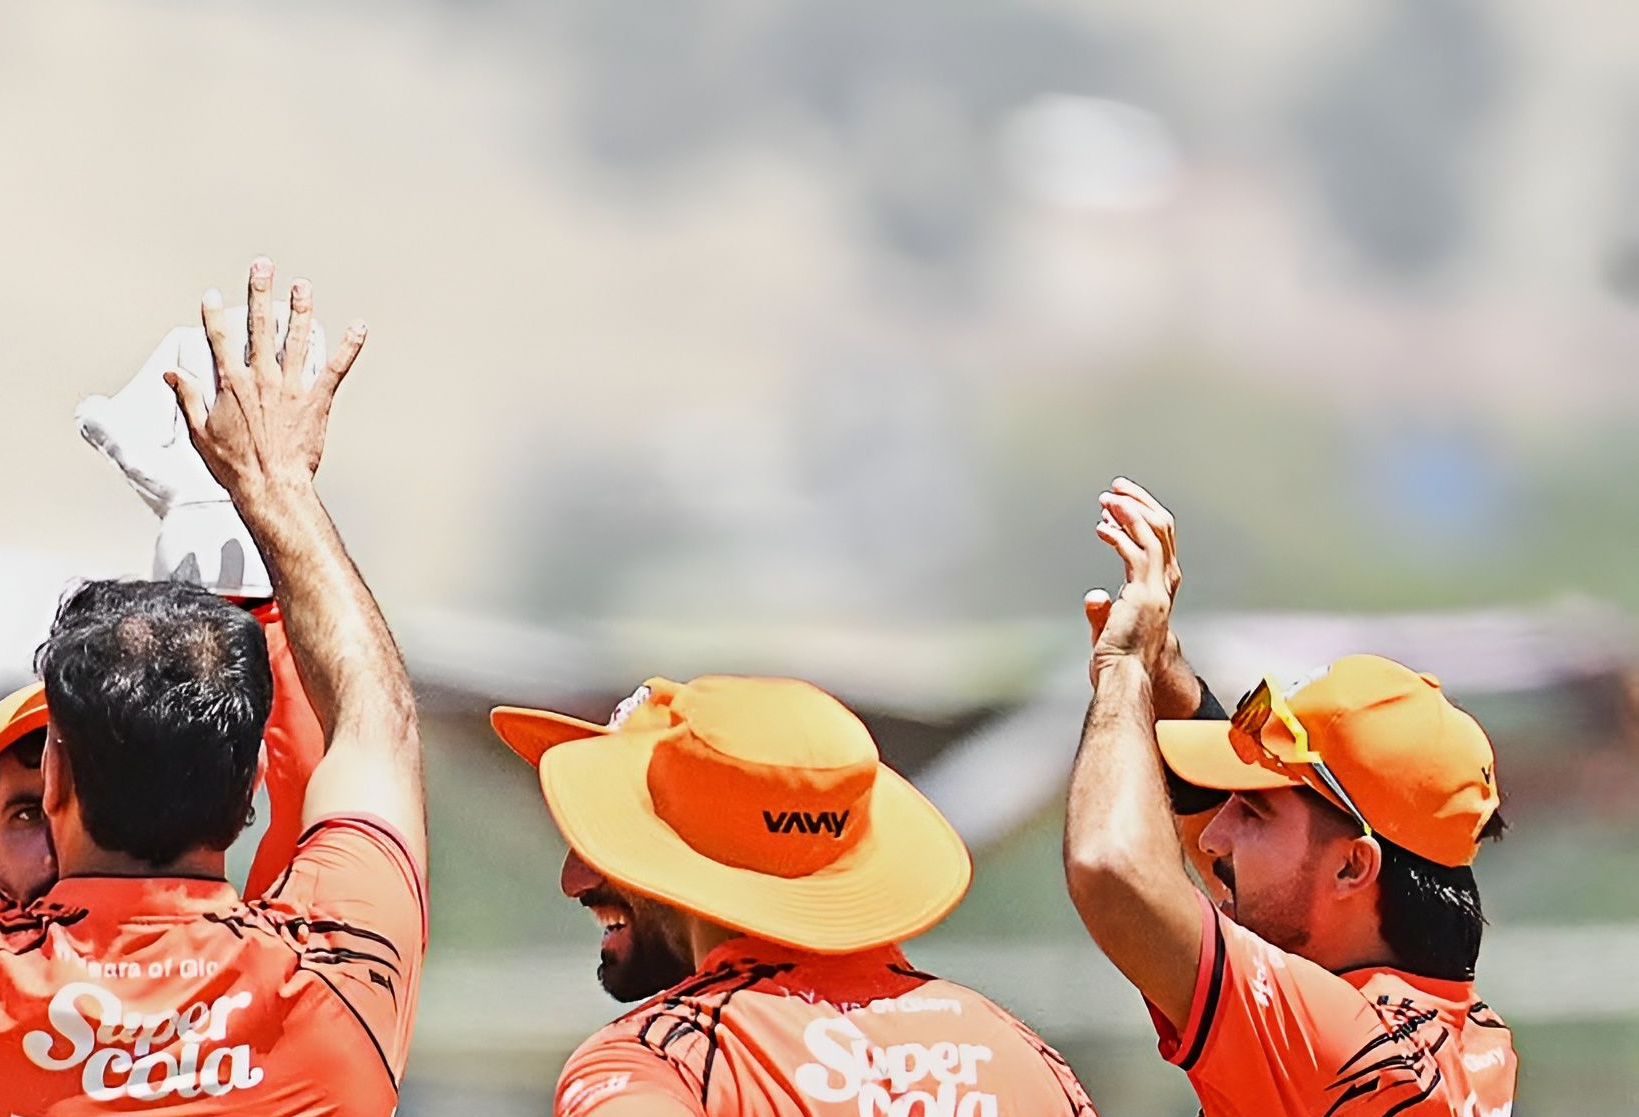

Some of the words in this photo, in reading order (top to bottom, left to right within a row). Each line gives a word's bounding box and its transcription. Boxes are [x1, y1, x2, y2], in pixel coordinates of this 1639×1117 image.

[147, 958, 173, 978] of
[22, 982, 253, 1071] Super
[795, 1016, 993, 1103] Super
